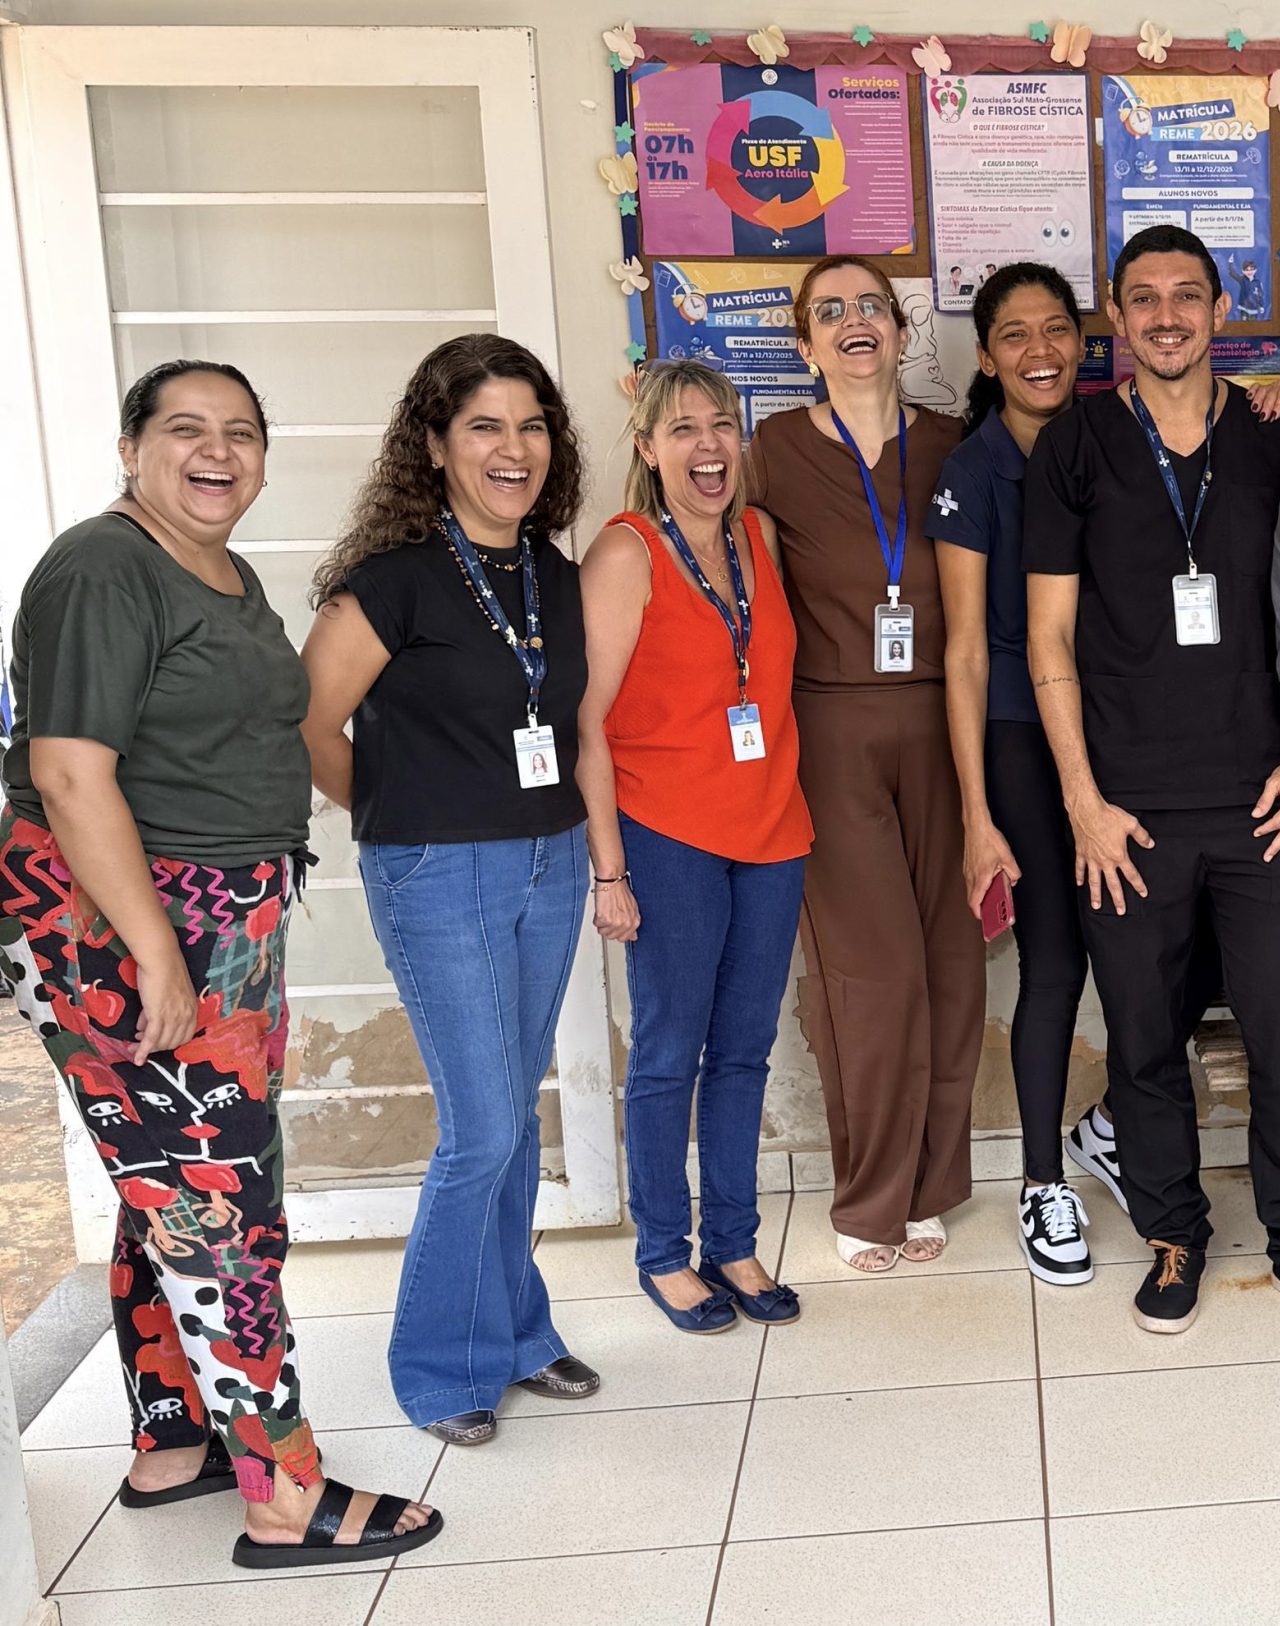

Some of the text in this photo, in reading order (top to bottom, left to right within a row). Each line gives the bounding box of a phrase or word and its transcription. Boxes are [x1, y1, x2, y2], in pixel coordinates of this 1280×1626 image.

[842, 76, 899, 88] Serviços
[1006, 82, 1048, 94] ASMFC
[828, 88, 900, 99] Ofertados:
[972, 96, 1082, 104] Associação Sul Mato-Grossense
[972, 104, 1084, 116] de FIBROSE CÍSTICA
[1157, 103, 1230, 122] MATRÍCULA
[1160, 120, 1258, 140] REME 2026
[645, 134, 694, 154] 07h
[748, 145, 802, 168] USF
[1176, 152, 1230, 160] REMATRÍCULA
[646, 160, 688, 180] 17h
[745, 168, 808, 178] Aero Itália
[712, 291, 788, 308] MATRÍCULA
[716, 315, 752, 326] REME
[734, 338, 789, 346] REMATRÍCULA
